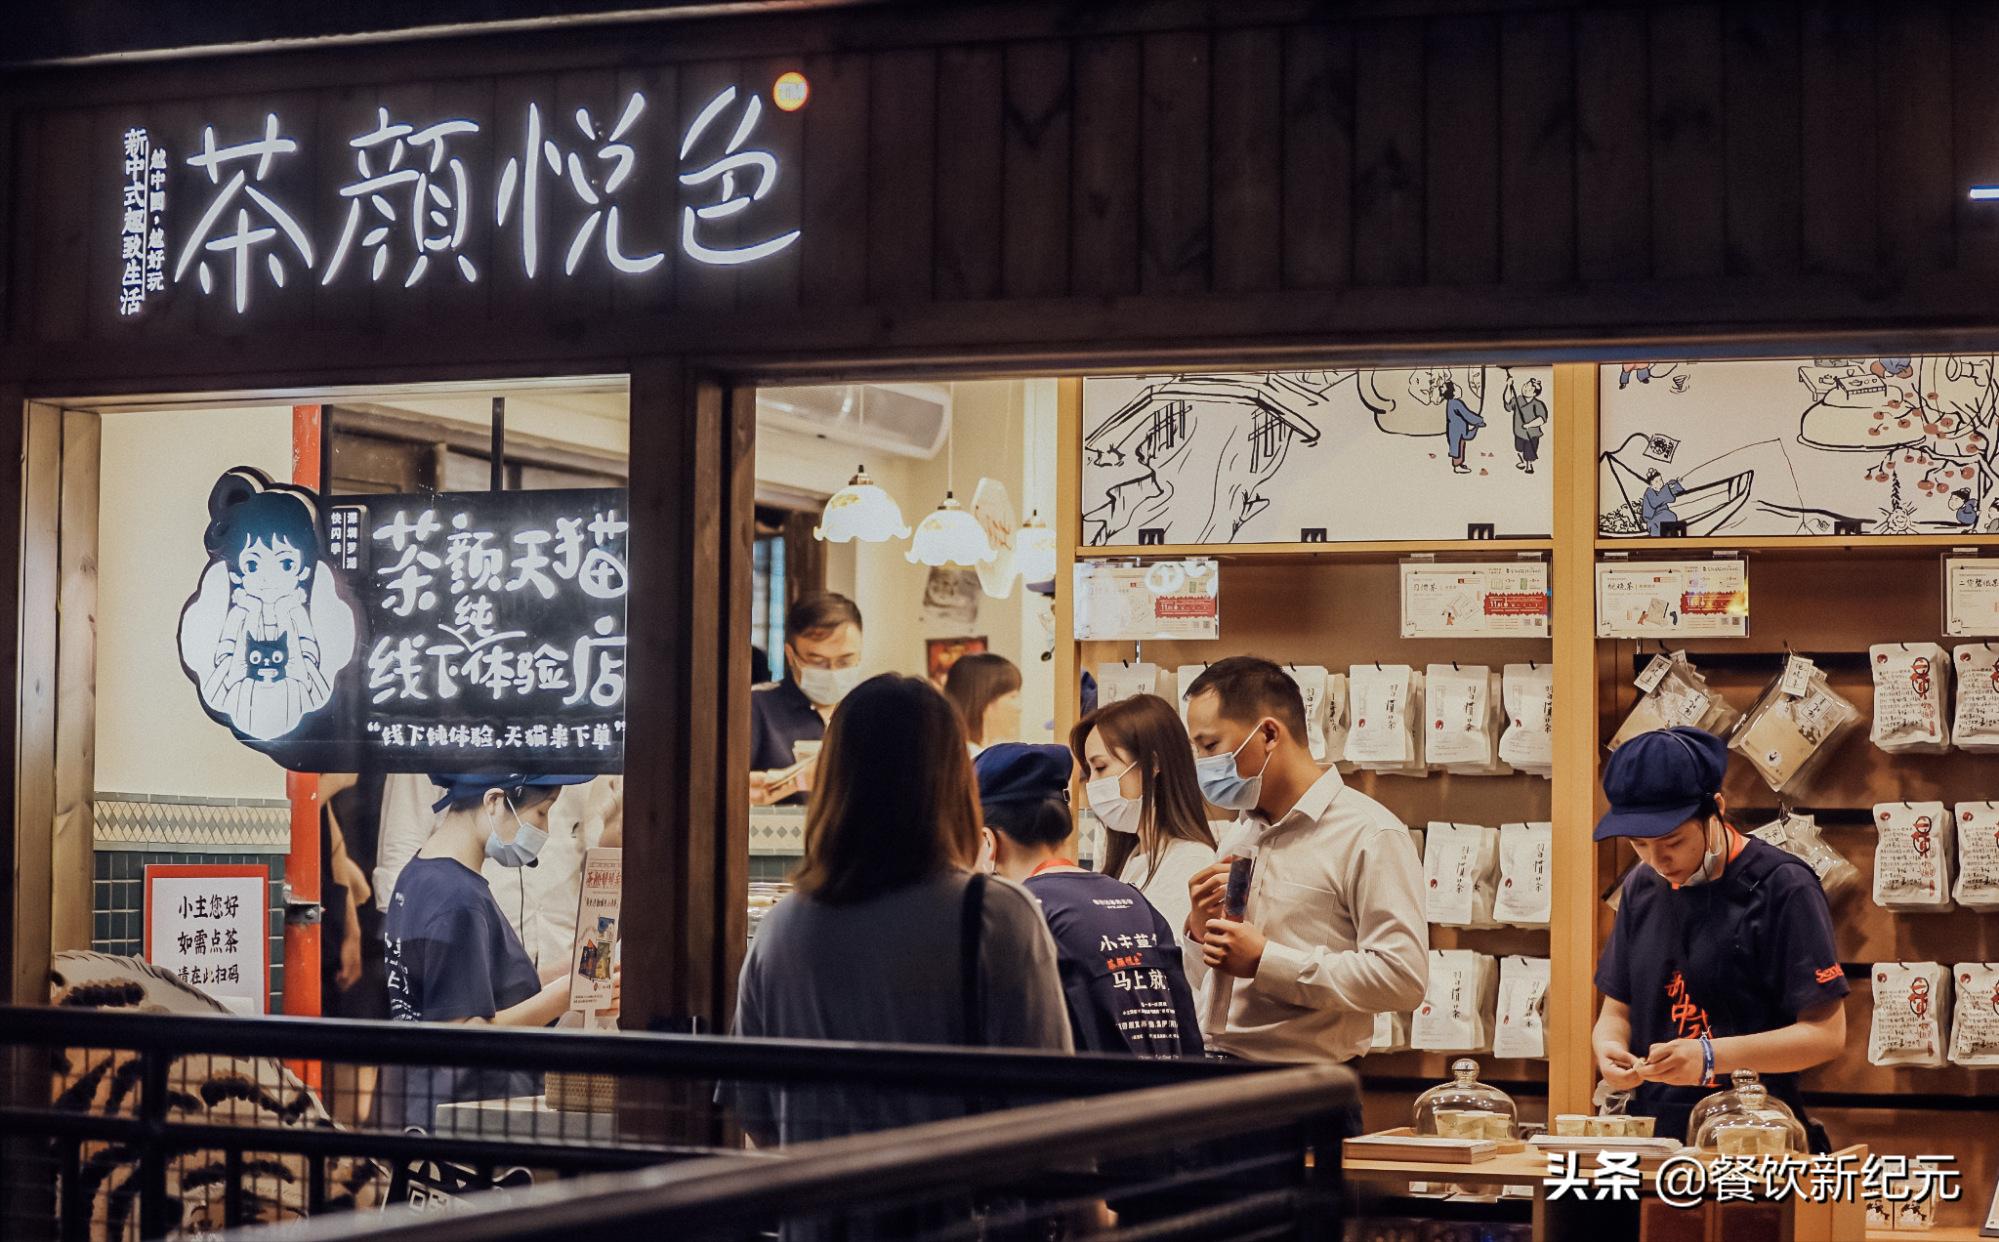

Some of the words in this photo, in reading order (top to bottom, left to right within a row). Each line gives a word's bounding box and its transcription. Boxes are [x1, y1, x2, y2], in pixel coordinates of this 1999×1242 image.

[175, 86, 800, 313] 茶颜悦色
[372, 509, 628, 616] 茶颜天猫
[178, 894, 239, 919] 小主您好
[177, 928, 239, 955] 如需点茶
[178, 964, 240, 985] 请在此扫码
[1113, 969, 1170, 991] 马上就
